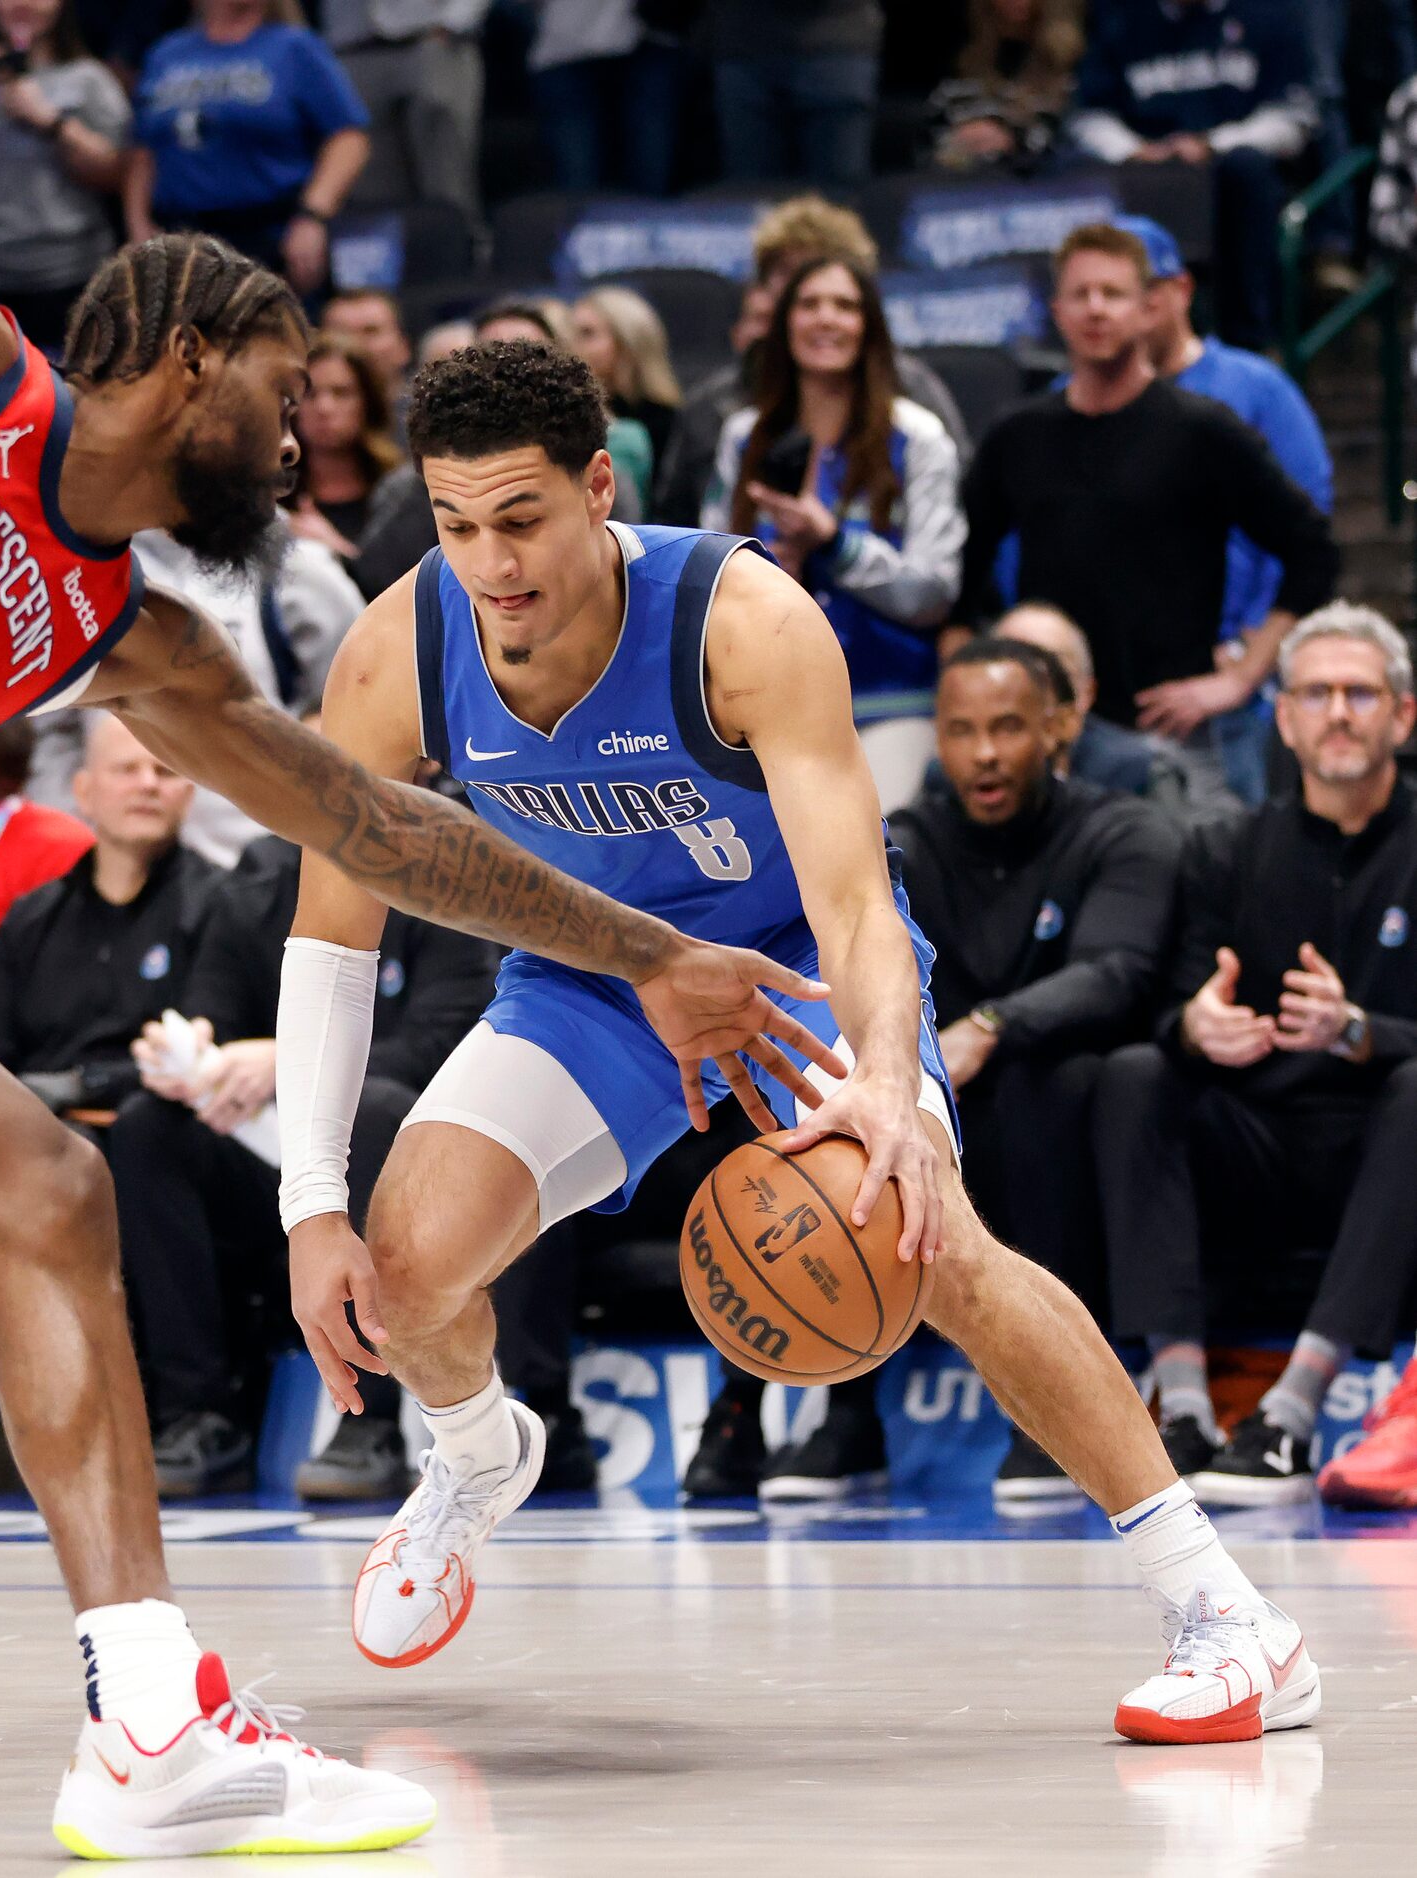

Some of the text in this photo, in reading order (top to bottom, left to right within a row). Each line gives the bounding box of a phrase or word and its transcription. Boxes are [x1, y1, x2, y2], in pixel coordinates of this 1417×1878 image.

[62, 566, 100, 642] ibotta
[597, 731, 670, 756] chime
[468, 778, 710, 837] DALLAS
[670, 816, 753, 882] 8
[689, 1206, 791, 1362] Wilson
